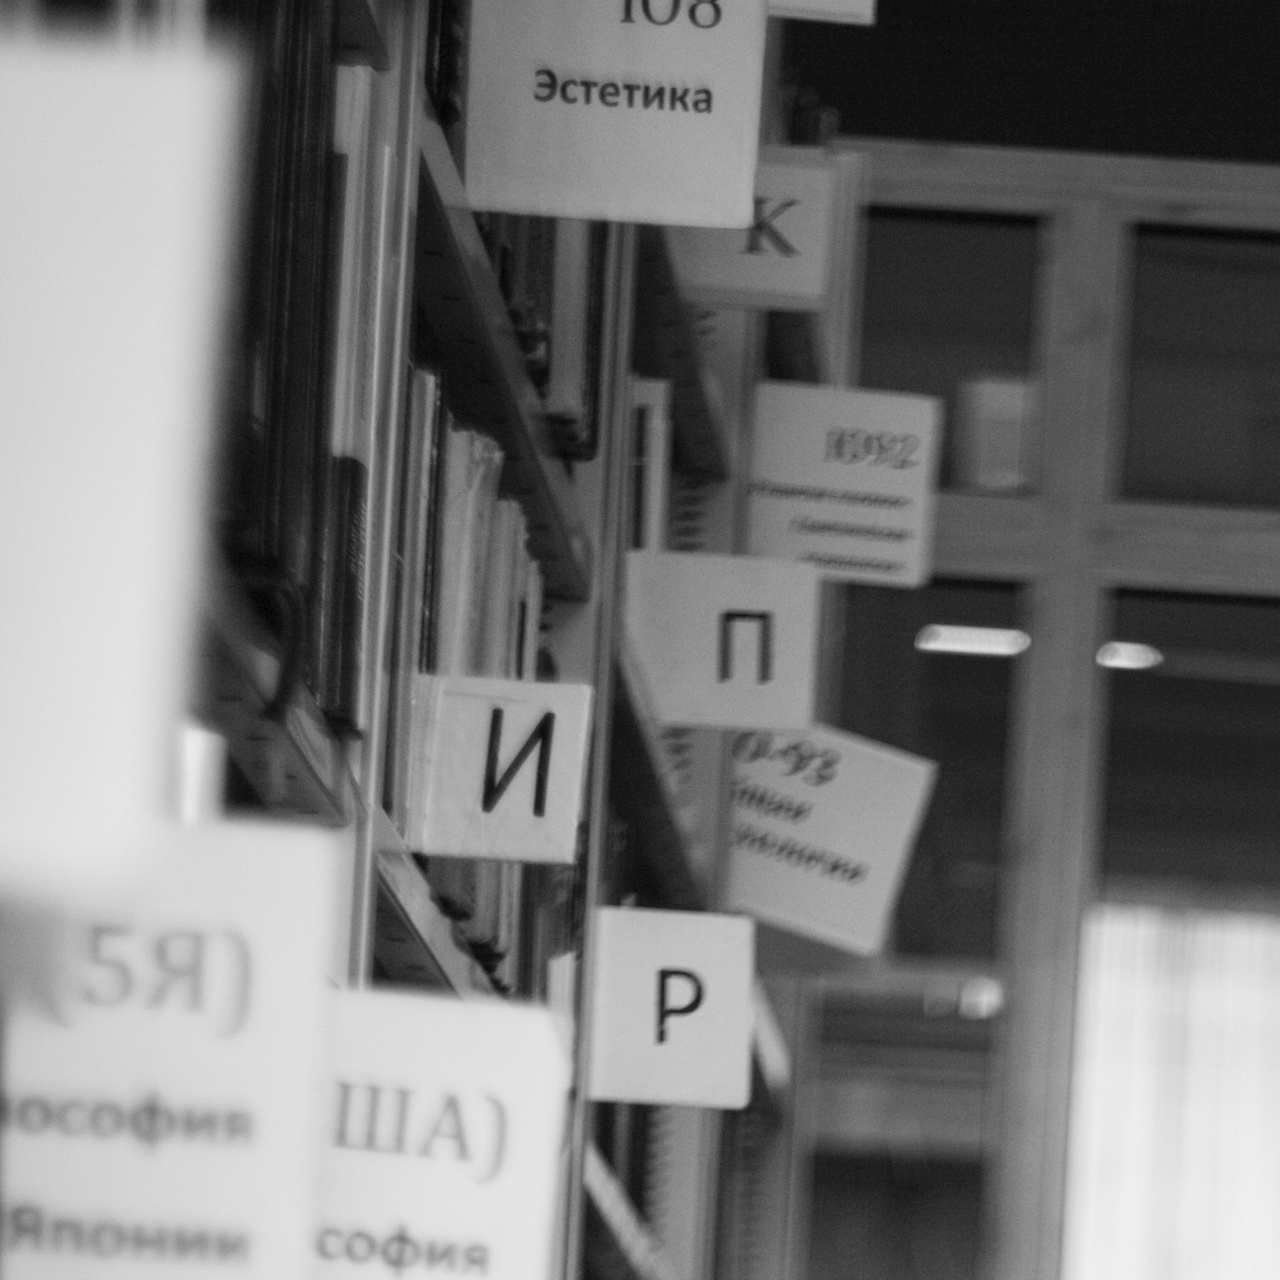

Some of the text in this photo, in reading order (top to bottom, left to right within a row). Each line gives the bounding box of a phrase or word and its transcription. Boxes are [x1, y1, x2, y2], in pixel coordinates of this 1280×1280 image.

[533, 68, 713, 114] Эстетика
[744, 196, 802, 258] К
[716, 606, 774, 687] П
[481, 707, 557, 819] И
[656, 968, 706, 1045] Р
